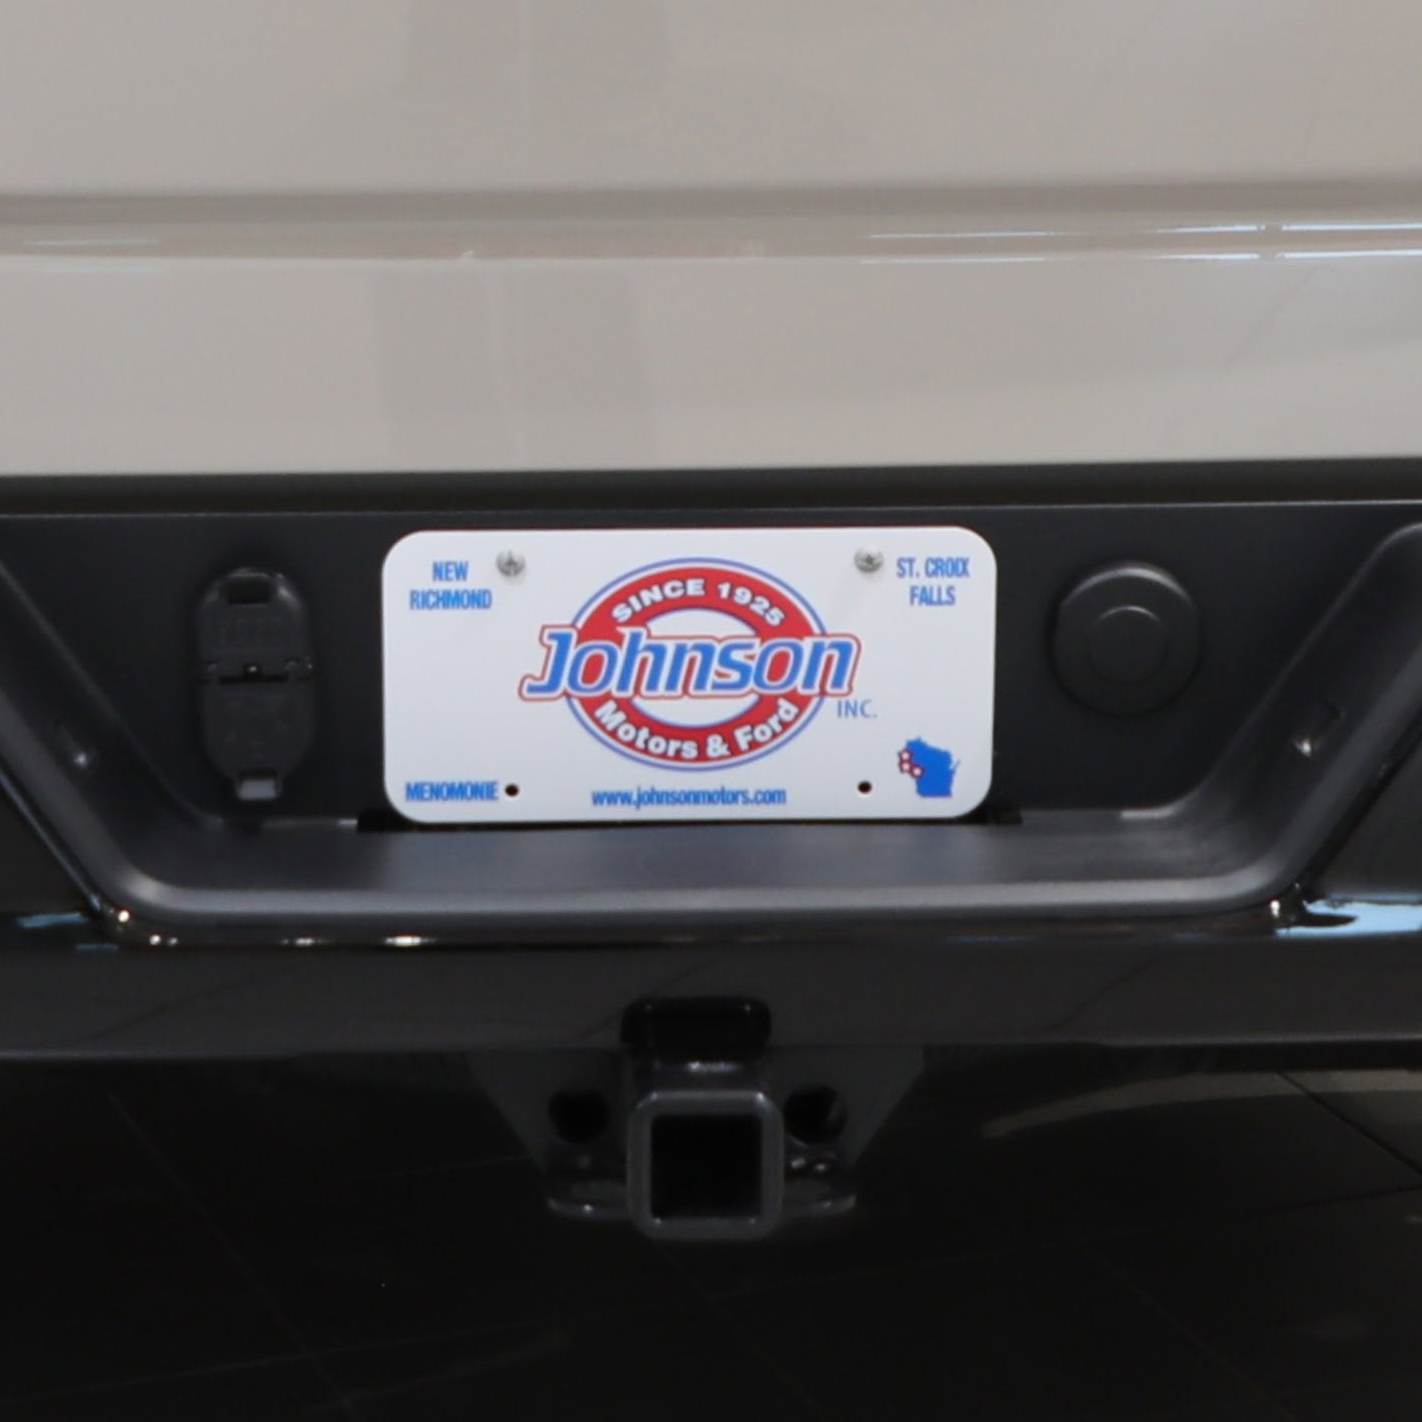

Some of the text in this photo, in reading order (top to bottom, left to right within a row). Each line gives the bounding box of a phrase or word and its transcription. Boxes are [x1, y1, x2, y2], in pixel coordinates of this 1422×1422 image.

[432, 561, 469, 582] NEW
[897, 557, 971, 579] ST. CROIX
[409, 589, 493, 610] RICHMOND
[611, 578, 786, 627] SINCE 1925
[909, 585, 957, 606] FALLS
[524, 630, 856, 695] Johnson
[837, 699, 878, 719] INC.
[593, 697, 801, 760] Motors & Ford
[405, 781, 498, 802] MENOMONIE
[591, 787, 788, 810] www.johnsonmotors.com
